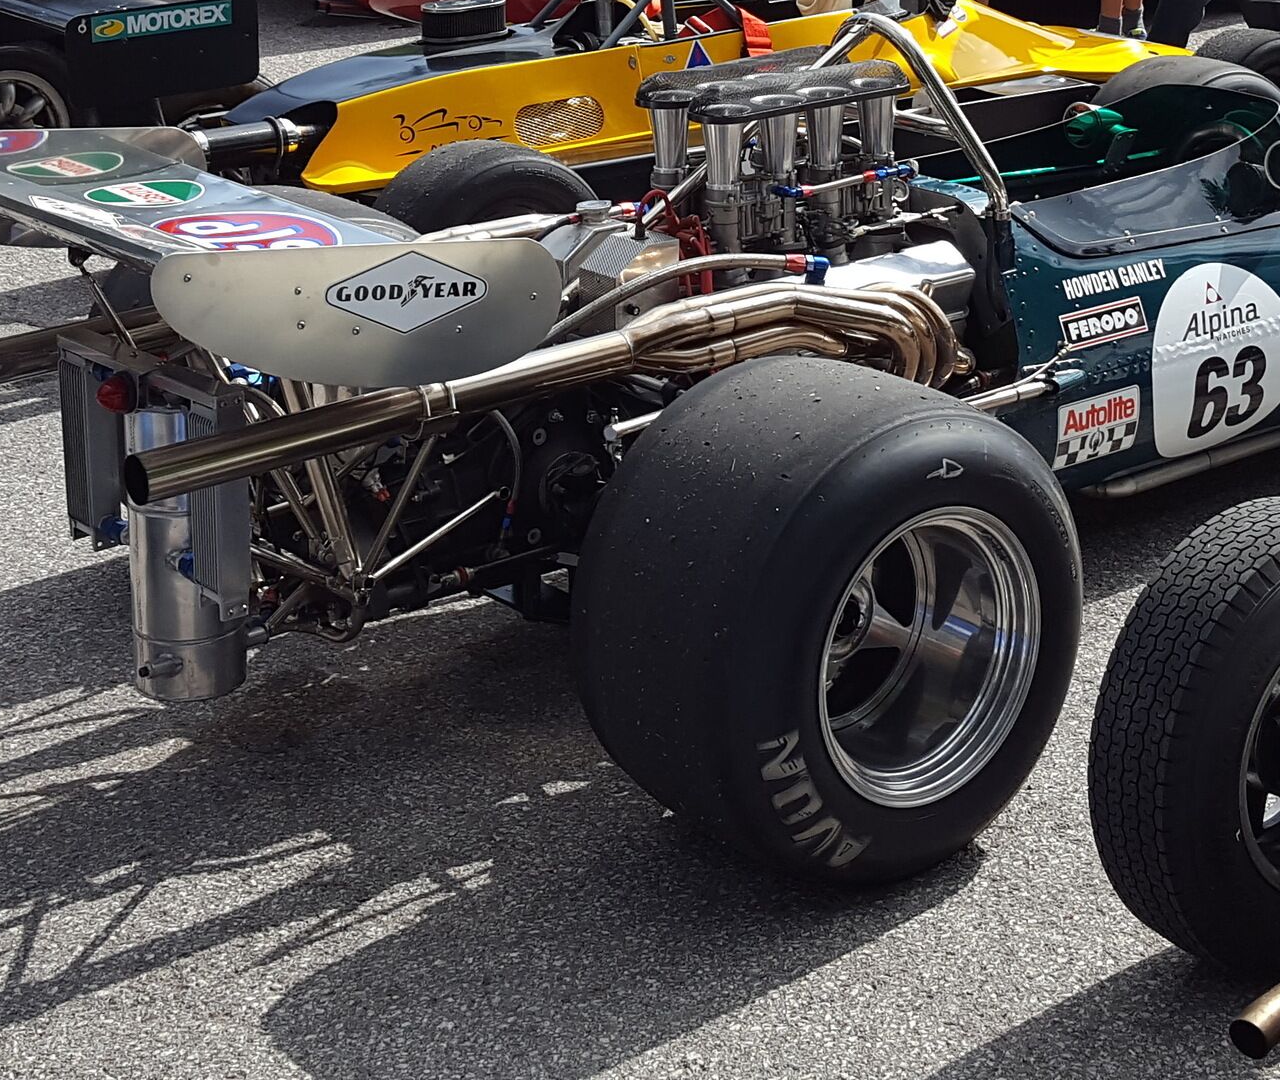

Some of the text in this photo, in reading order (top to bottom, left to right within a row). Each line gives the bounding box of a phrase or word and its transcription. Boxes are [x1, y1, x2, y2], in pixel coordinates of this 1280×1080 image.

[126, 3, 228, 33] MOTOREX
[1062, 258, 1167, 300] HOWDEN GANLEY
[1068, 311, 1139, 341] FERODO
[1182, 301, 1261, 342] Alpina
[1216, 325, 1252, 342] WATCHES
[1186, 345, 1268, 440] 63
[1063, 396, 1136, 436] Autolite
